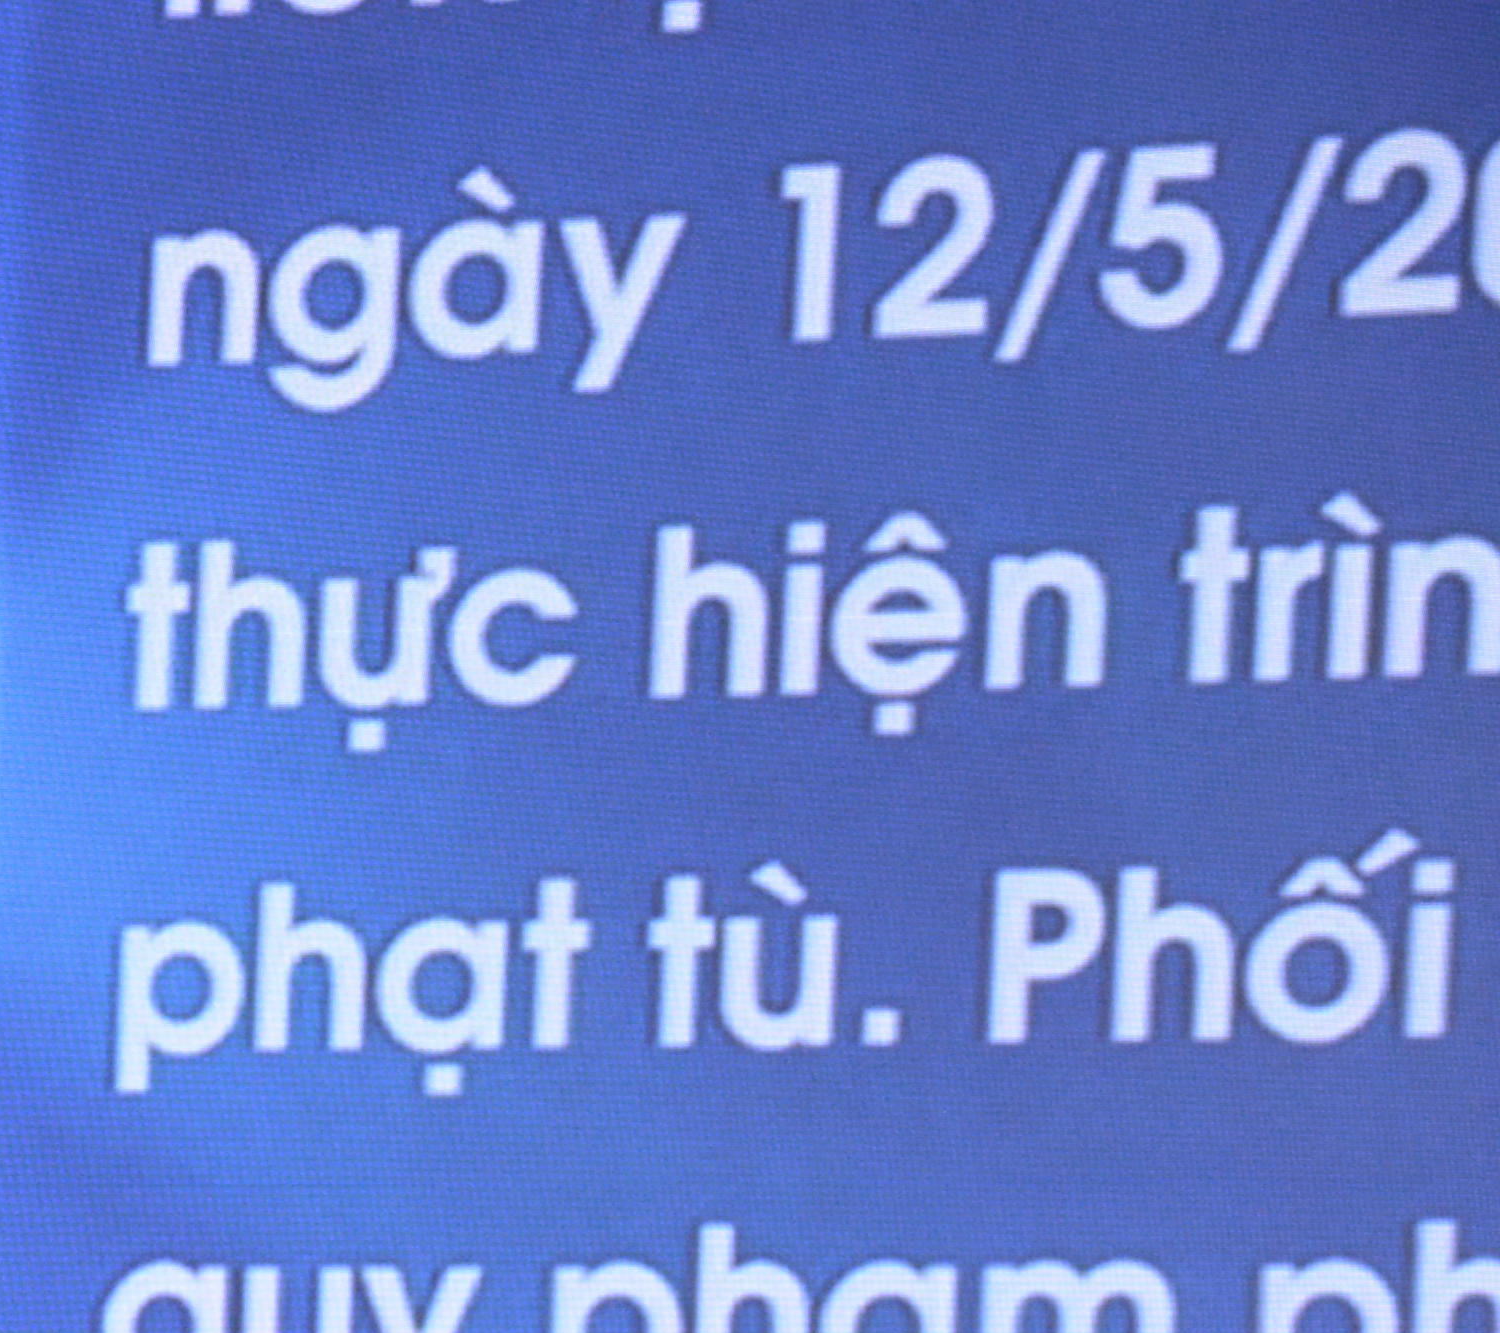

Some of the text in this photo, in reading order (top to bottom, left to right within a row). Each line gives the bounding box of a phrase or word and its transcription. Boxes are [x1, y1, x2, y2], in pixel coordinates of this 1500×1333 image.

[151, 172, 682, 410] ngày
[130, 541, 575, 751] thực
[654, 516, 1104, 734] hiện
[119, 833, 1452, 1095] phạt tù. Phối
